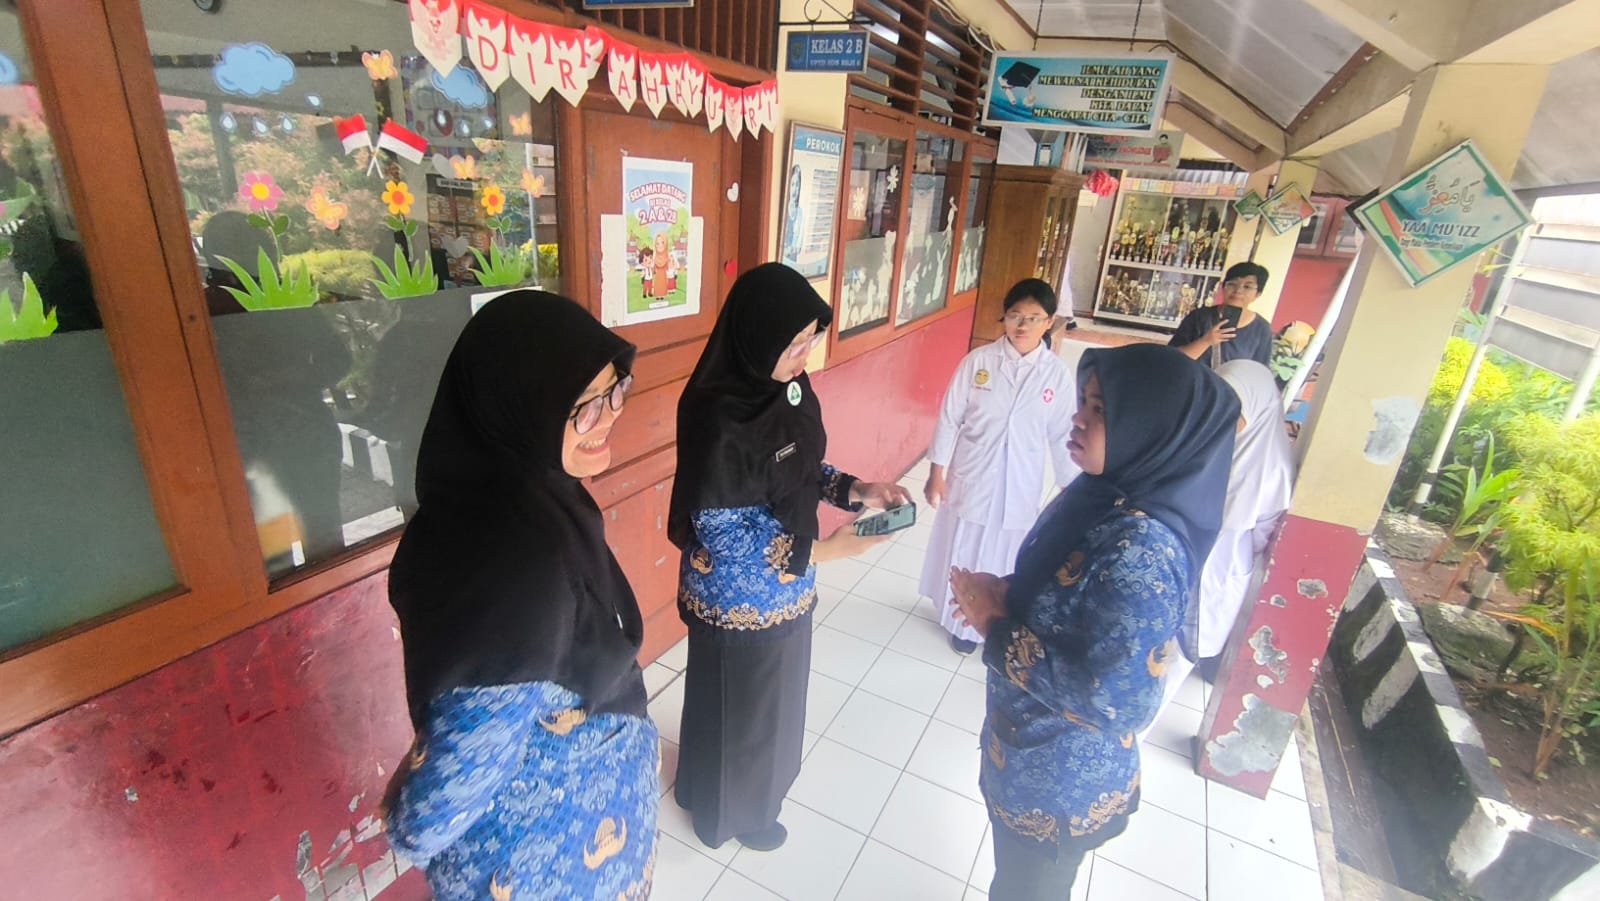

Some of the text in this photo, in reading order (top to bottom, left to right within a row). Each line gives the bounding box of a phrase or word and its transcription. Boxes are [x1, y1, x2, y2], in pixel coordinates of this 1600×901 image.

[811, 38, 864, 54] KELAS 2 B
[1080, 65, 1161, 77] ILMULAH YANG
[1081, 88, 1126, 99] DENGAN
[1117, 101, 1153, 112] DAPAT
[806, 137, 841, 152] PEROKOK
[629, 183, 687, 204] SELAMAT DATANG
[1402, 221, 1481, 238] YAA MU'IZZ
